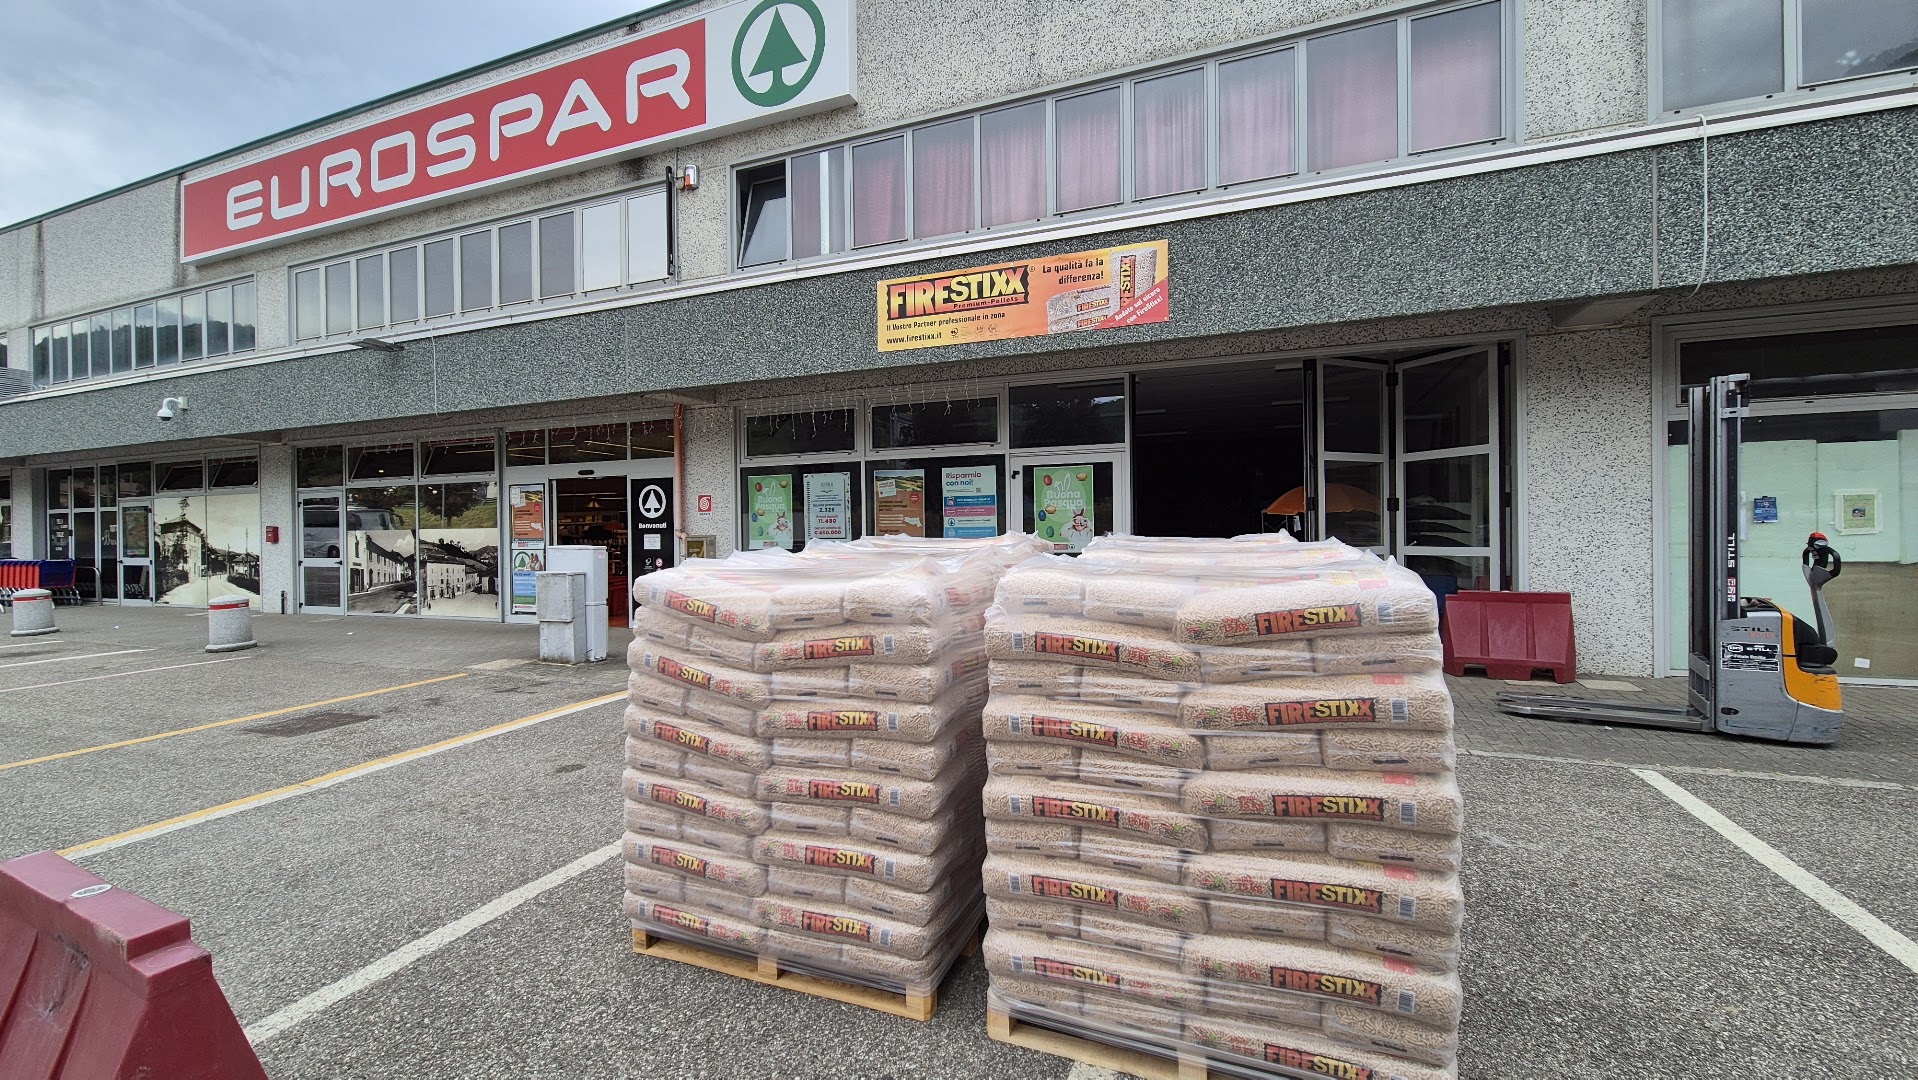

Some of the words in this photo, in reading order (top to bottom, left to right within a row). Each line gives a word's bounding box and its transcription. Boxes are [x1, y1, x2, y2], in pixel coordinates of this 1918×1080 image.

[226, 47, 692, 231] EUROSPAR
[1042, 265, 1051, 273] La
[1054, 261, 1083, 273] qualità
[1085, 259, 1093, 267] fa
[1096, 257, 1104, 266] la
[1058, 271, 1104, 285] differenza!
[889, 267, 1026, 319] FIRESTIXX
[953, 296, 1019, 309] Premium-Pellets
[893, 322, 912, 331] Vostro
[913, 320, 936, 329] Partner
[938, 313, 981, 327] professionale
[991, 311, 1006, 319] zona
[886, 332, 942, 344] www.firestixx.it
[945, 471, 982, 480] Risparmia
[1044, 499, 1084, 511] Pasqua
[1046, 490, 1081, 499] Buona
[756, 503, 785, 512] Pasqua
[638, 521, 667, 529] Benvenuti
[1727, 532, 1736, 568] STILL
[1257, 605, 1359, 635] FIRESTIXX
[805, 636, 872, 659] FIRESTIXX
[1036, 632, 1118, 658] FIRESTIXX
[809, 711, 877, 730] FIRESTIXX
[1267, 700, 1374, 725] FIRESTIXX
[1034, 716, 1117, 743] FIRESTIXX
[810, 780, 879, 799] FIRESTIXX
[1034, 796, 1117, 823] FIRESTIXX
[1275, 796, 1382, 817] FIRESTIXX
[805, 846, 875, 868] FIRESTIXX
[1033, 875, 1117, 905] FIRESTIXX
[1273, 879, 1381, 908] FIRESTIXX
[802, 911, 870, 937] FIRESTIXX
[1272, 967, 1380, 1001] FIRESTIXX
